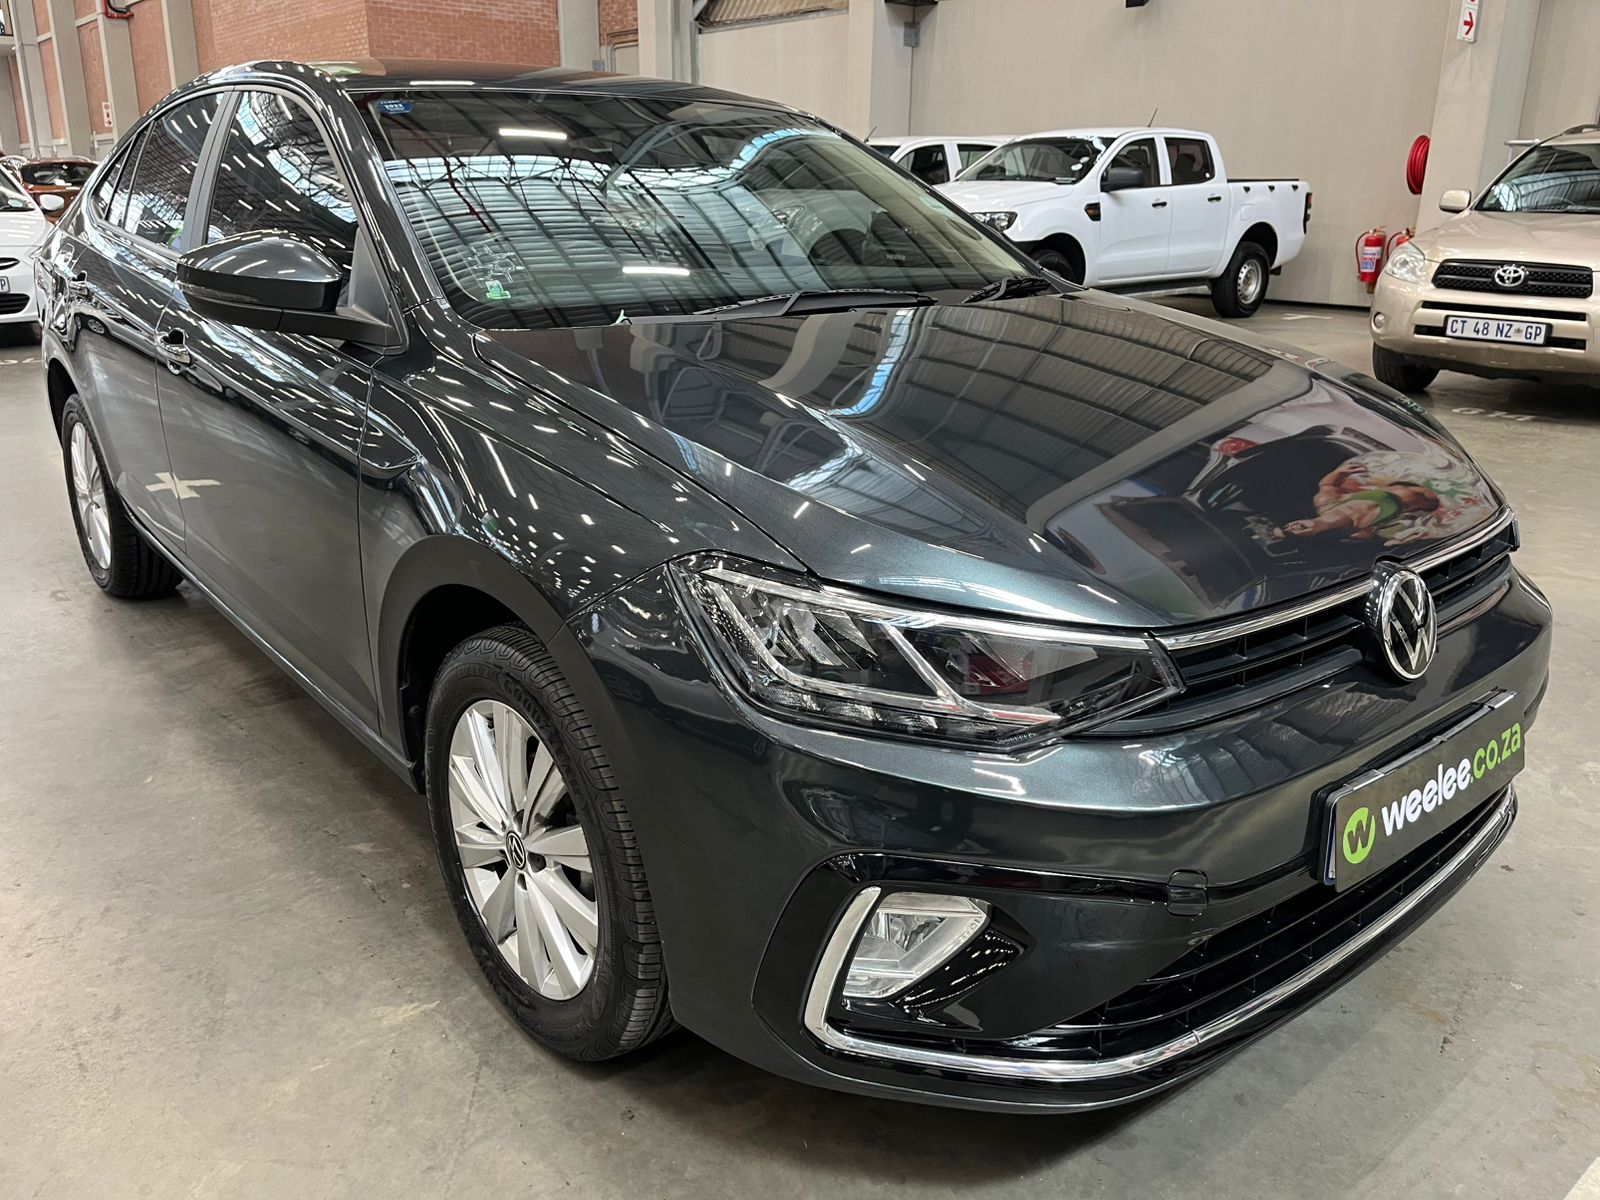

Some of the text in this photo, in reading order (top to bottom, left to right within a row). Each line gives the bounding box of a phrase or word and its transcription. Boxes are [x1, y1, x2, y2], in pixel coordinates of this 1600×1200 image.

[1450, 319, 1542, 341] CT 48 NZ GP
[1381, 721, 1522, 837] weelee.co.za
